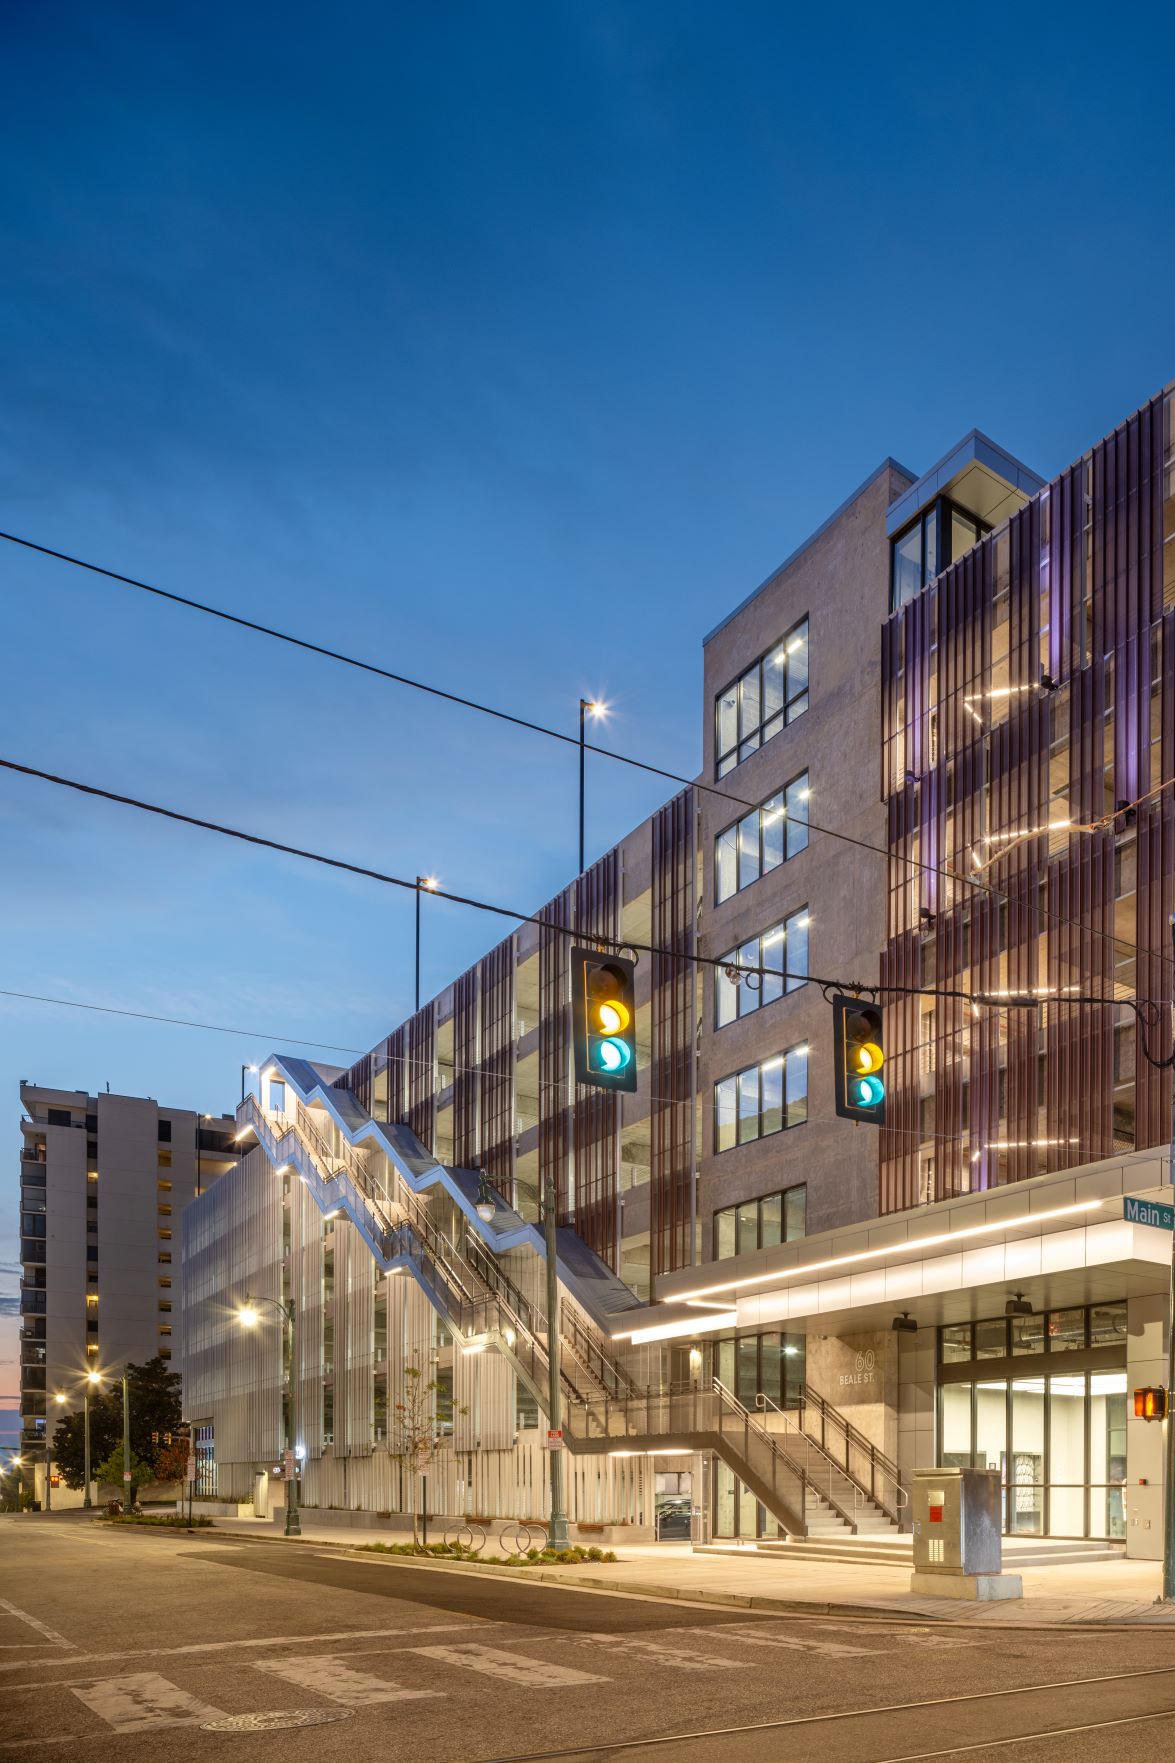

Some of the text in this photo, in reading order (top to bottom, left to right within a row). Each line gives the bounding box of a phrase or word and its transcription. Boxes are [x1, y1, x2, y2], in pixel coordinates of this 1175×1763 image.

[1126, 1200, 1171, 1226] Main St
[855, 1349, 875, 1371] 60
[839, 1373, 862, 1385] BEALE
